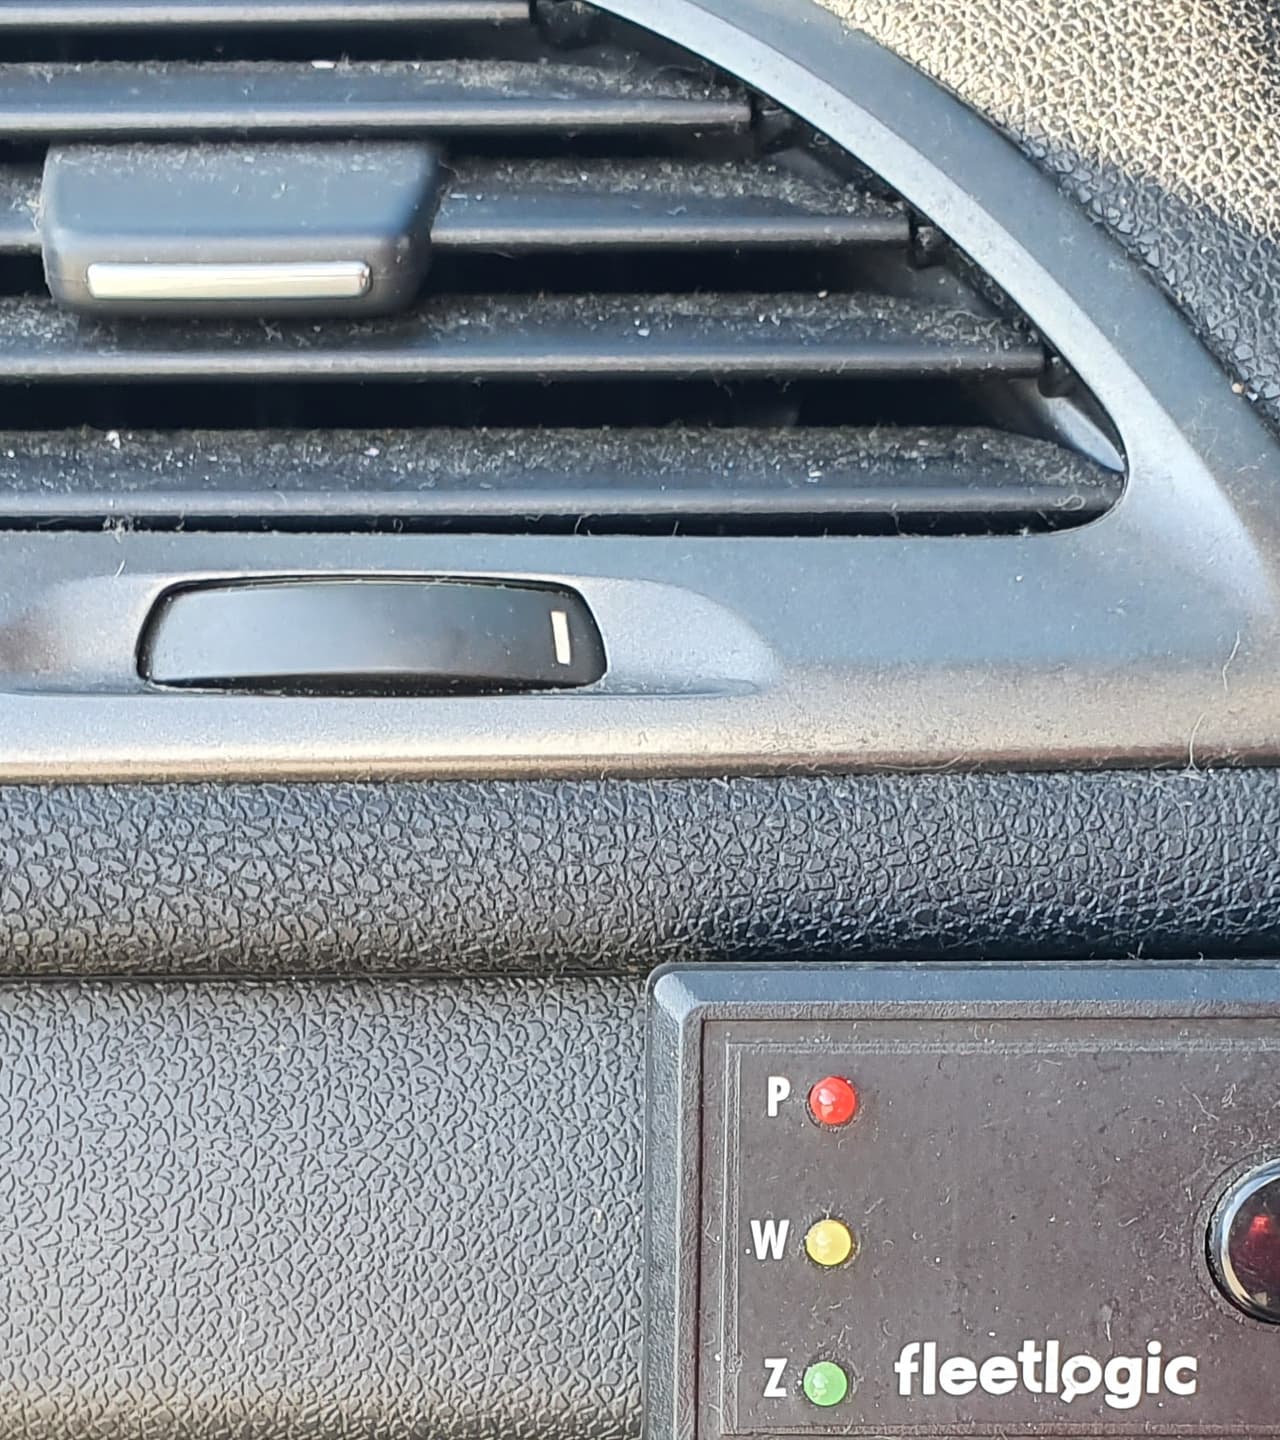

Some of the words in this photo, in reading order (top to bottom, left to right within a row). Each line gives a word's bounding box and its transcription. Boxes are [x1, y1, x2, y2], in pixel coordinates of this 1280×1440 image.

[767, 1077, 791, 1117] P
[750, 1219, 790, 1260] W
[763, 1358, 788, 1398] Z
[894, 1340, 1199, 1409] fleetlogic
